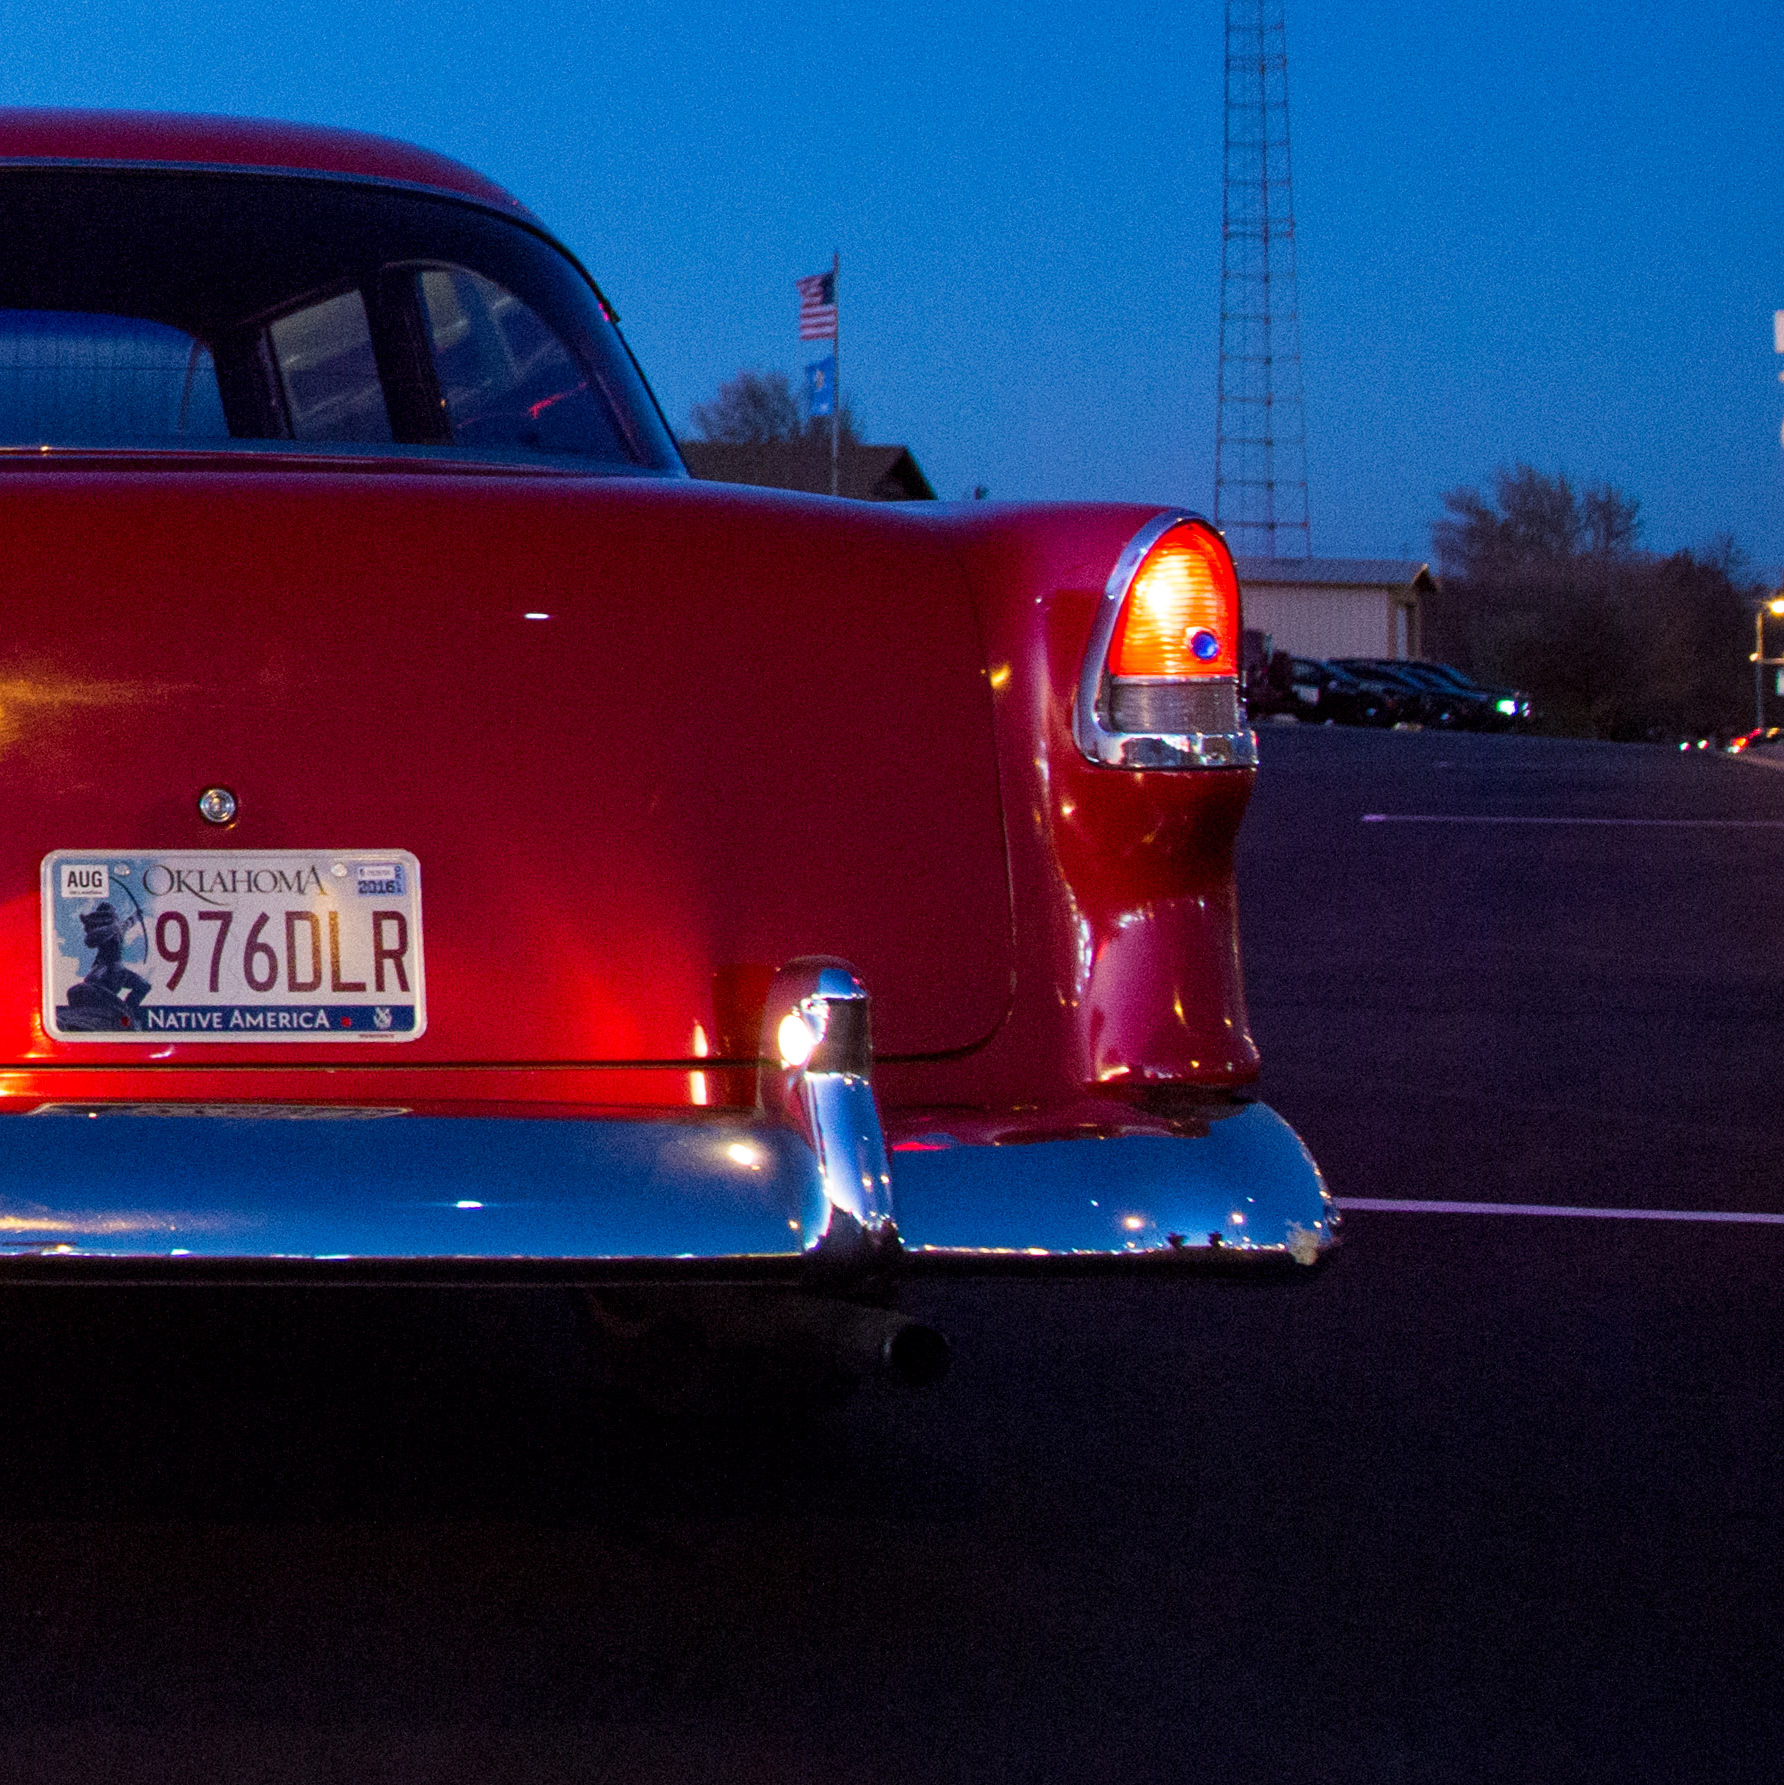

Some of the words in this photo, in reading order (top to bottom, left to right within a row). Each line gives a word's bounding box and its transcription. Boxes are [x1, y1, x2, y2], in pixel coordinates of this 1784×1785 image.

[67, 870, 103, 887] AUG
[142, 864, 328, 906] OKLAHOMA
[357, 880, 395, 894] 2016
[155, 910, 411, 993] 976DLR
[148, 1008, 223, 1029] NATIVE
[229, 1008, 331, 1029] AMERICA
